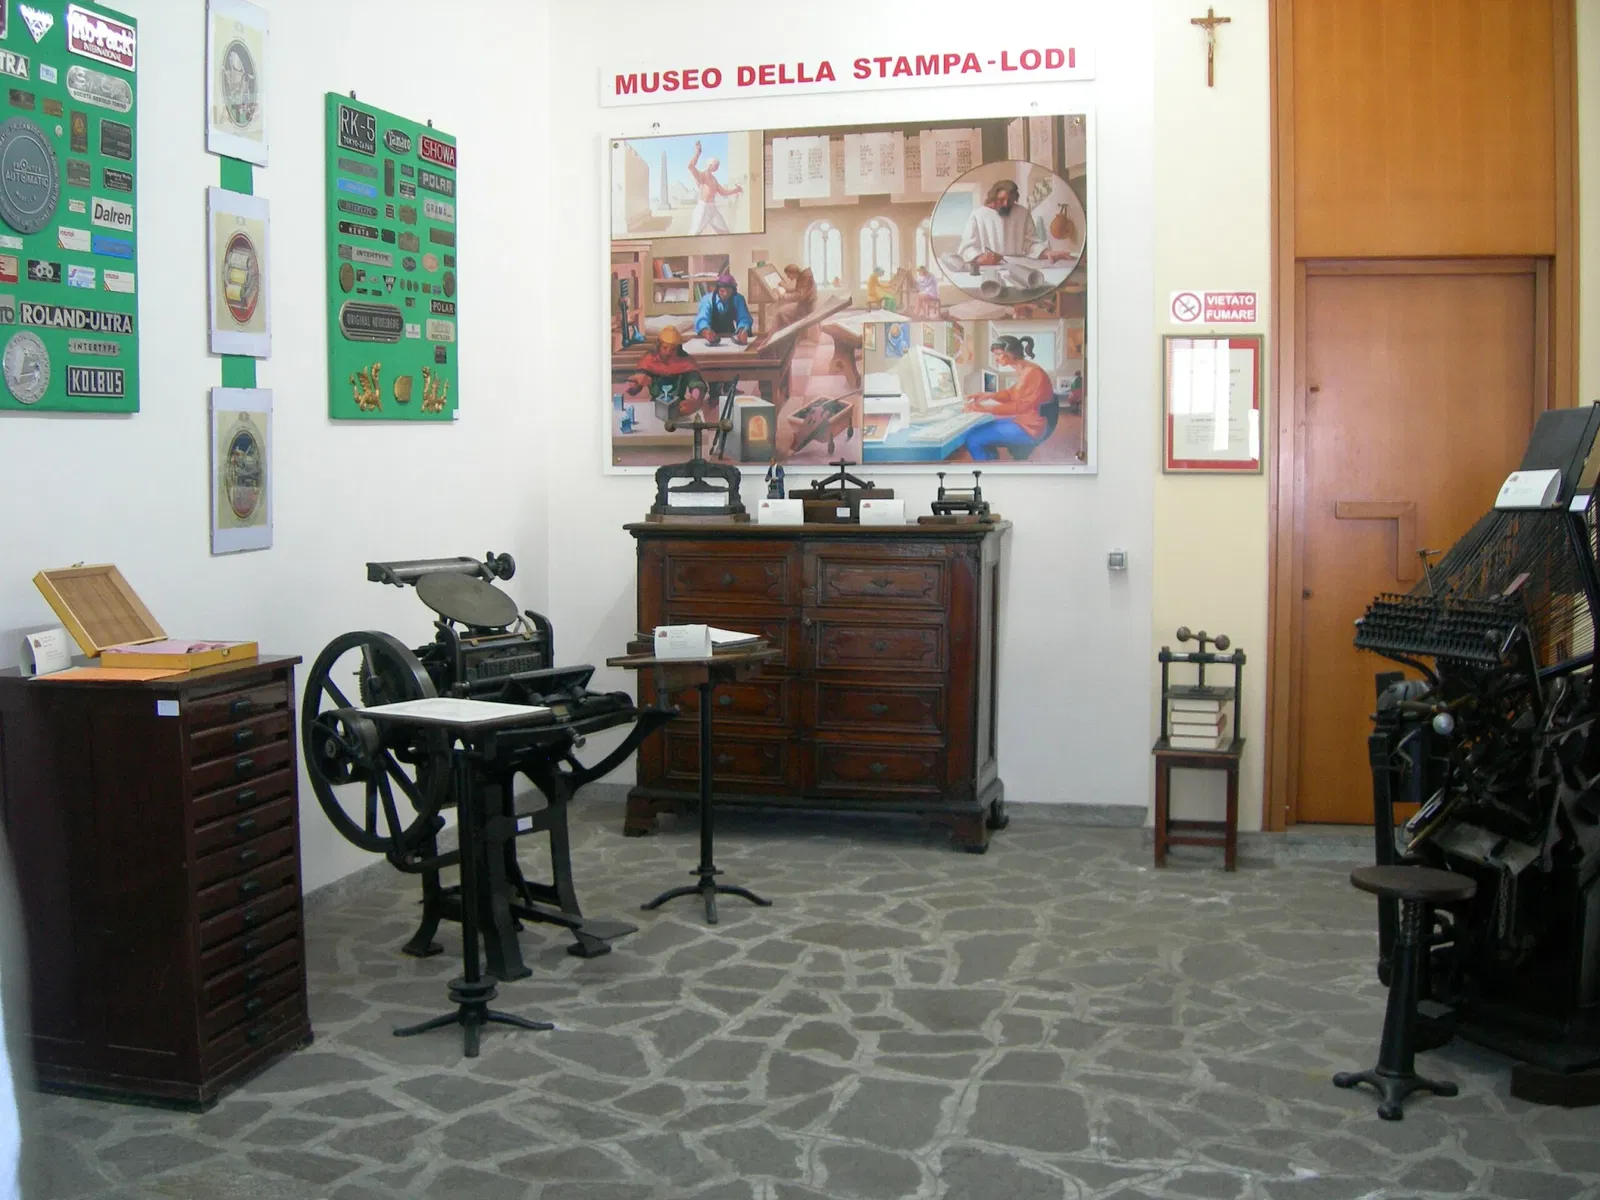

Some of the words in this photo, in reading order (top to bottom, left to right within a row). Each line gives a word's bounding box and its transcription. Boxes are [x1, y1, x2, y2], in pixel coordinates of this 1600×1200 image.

[615, 67, 722, 95] MUSEO
[737, 61, 836, 87] DELLA
[341, 107, 375, 142] RK-5
[423, 139, 456, 165] SHOWA
[422, 172, 453, 193] POLAR
[94, 203, 131, 226] Dalren
[432, 301, 454, 314] POLAR
[1206, 295, 1254, 305] VIETATO
[22, 304, 132, 333] ROLAND-ULTRA
[1206, 309, 1255, 320] FUMARE
[73, 341, 117, 354] INTERTYPE
[72, 369, 122, 394] KOLBUS
